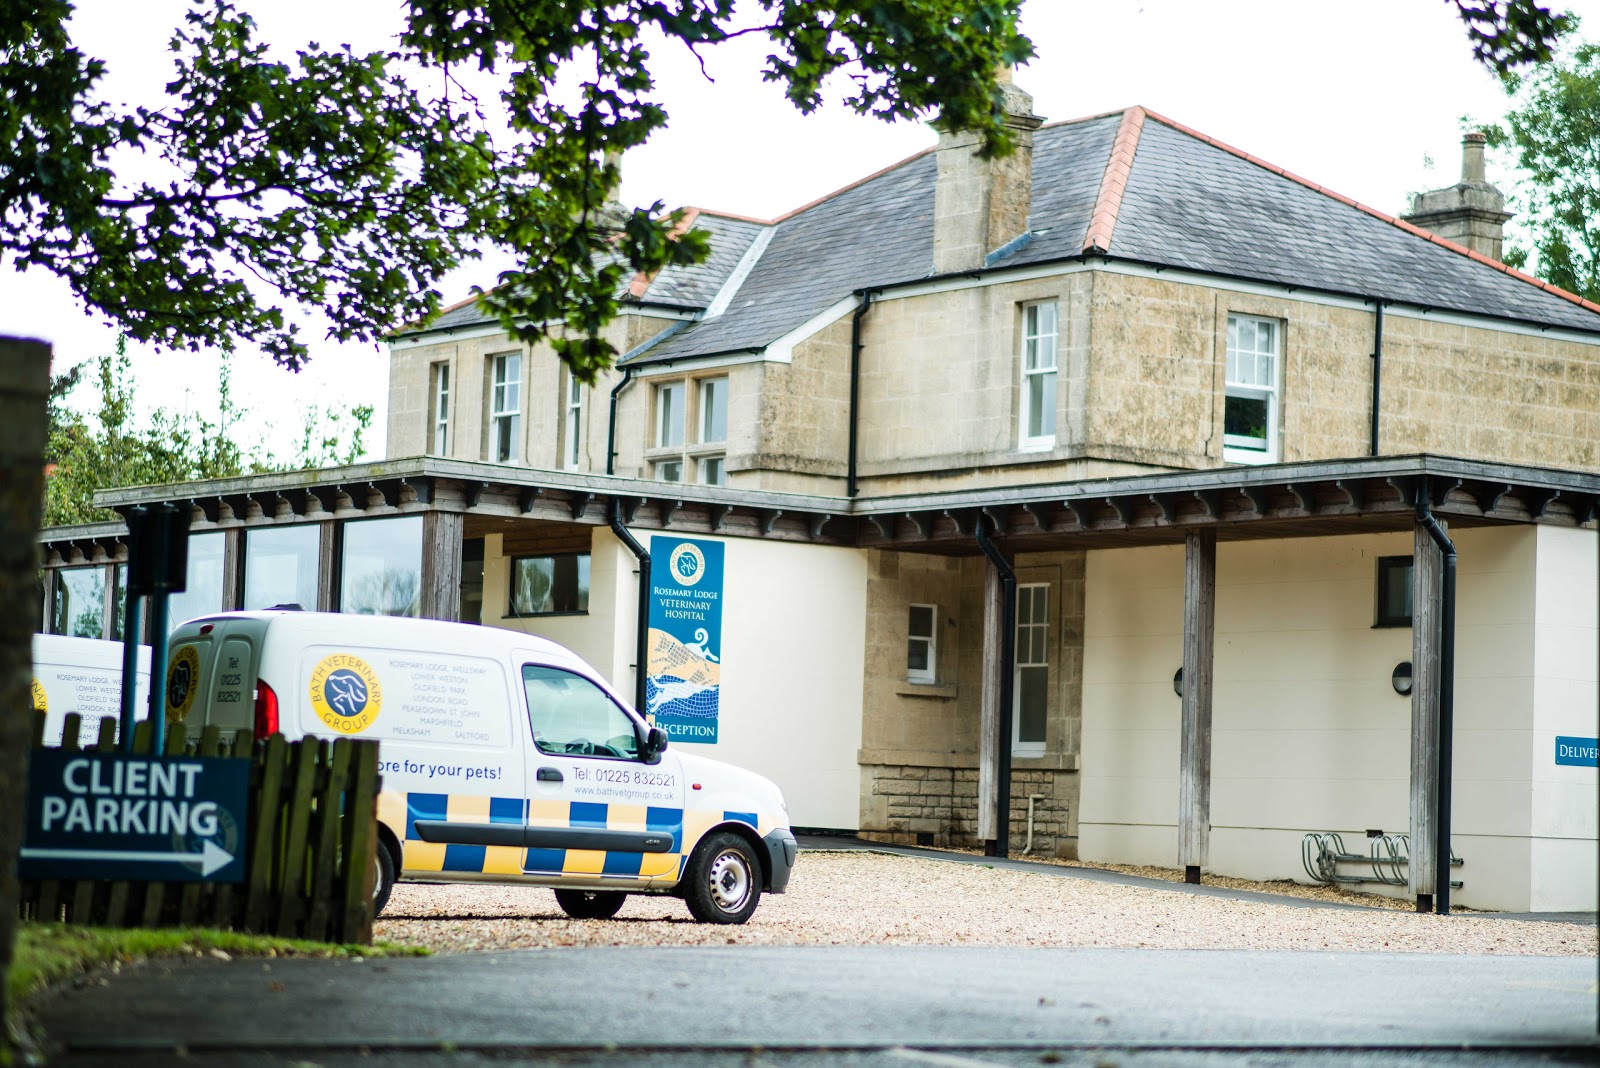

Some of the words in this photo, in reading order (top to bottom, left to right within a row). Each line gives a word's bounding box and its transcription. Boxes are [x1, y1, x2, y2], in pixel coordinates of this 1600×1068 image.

[680, 544, 704, 572] VETERINARY
[676, 575, 697, 584] GROUP
[654, 587, 692, 597] ROSEMARY
[694, 590, 718, 599] LODGE
[660, 599, 711, 610] VETERINARY
[665, 610, 705, 620] HOSPITAL
[389, 660, 423, 669] ROSEMARY
[452, 665, 487, 674] WELLSWAY
[57, 674, 87, 682] ROSEMARY
[221, 674, 241, 685] 01225
[312, 666, 327, 702] BATH
[324, 655, 381, 707] VETERINARY
[411, 673, 435, 681] LOWER
[100, 687, 121, 695] WESTO
[413, 683, 447, 693] OLDFIELD
[78, 694, 107, 703] OLDFIELD
[217, 691, 241, 703] 832521
[413, 695, 445, 704] LONDON
[448, 697, 468, 706] ROAD
[402, 705, 446, 715] PEASEDOWN
[460, 709, 480, 718] JOHN
[324, 713, 368, 731] GROUP
[420, 718, 463, 728] MARSHFIELD
[392, 727, 431, 736] MELKSHAM
[455, 731, 489, 741] SALTFORD
[377, 761, 400, 772] ore
[404, 760, 425, 774] for
[429, 764, 462, 778] your
[466, 766, 501, 780] pets!
[62, 758, 203, 798] CLIENT
[573, 767, 591, 780] Tel:
[596, 768, 630, 783] 01225
[634, 771, 675, 787] 832521
[575, 786, 674, 800] www.bathvetgroup.co.uk
[42, 796, 218, 836] PARKING
